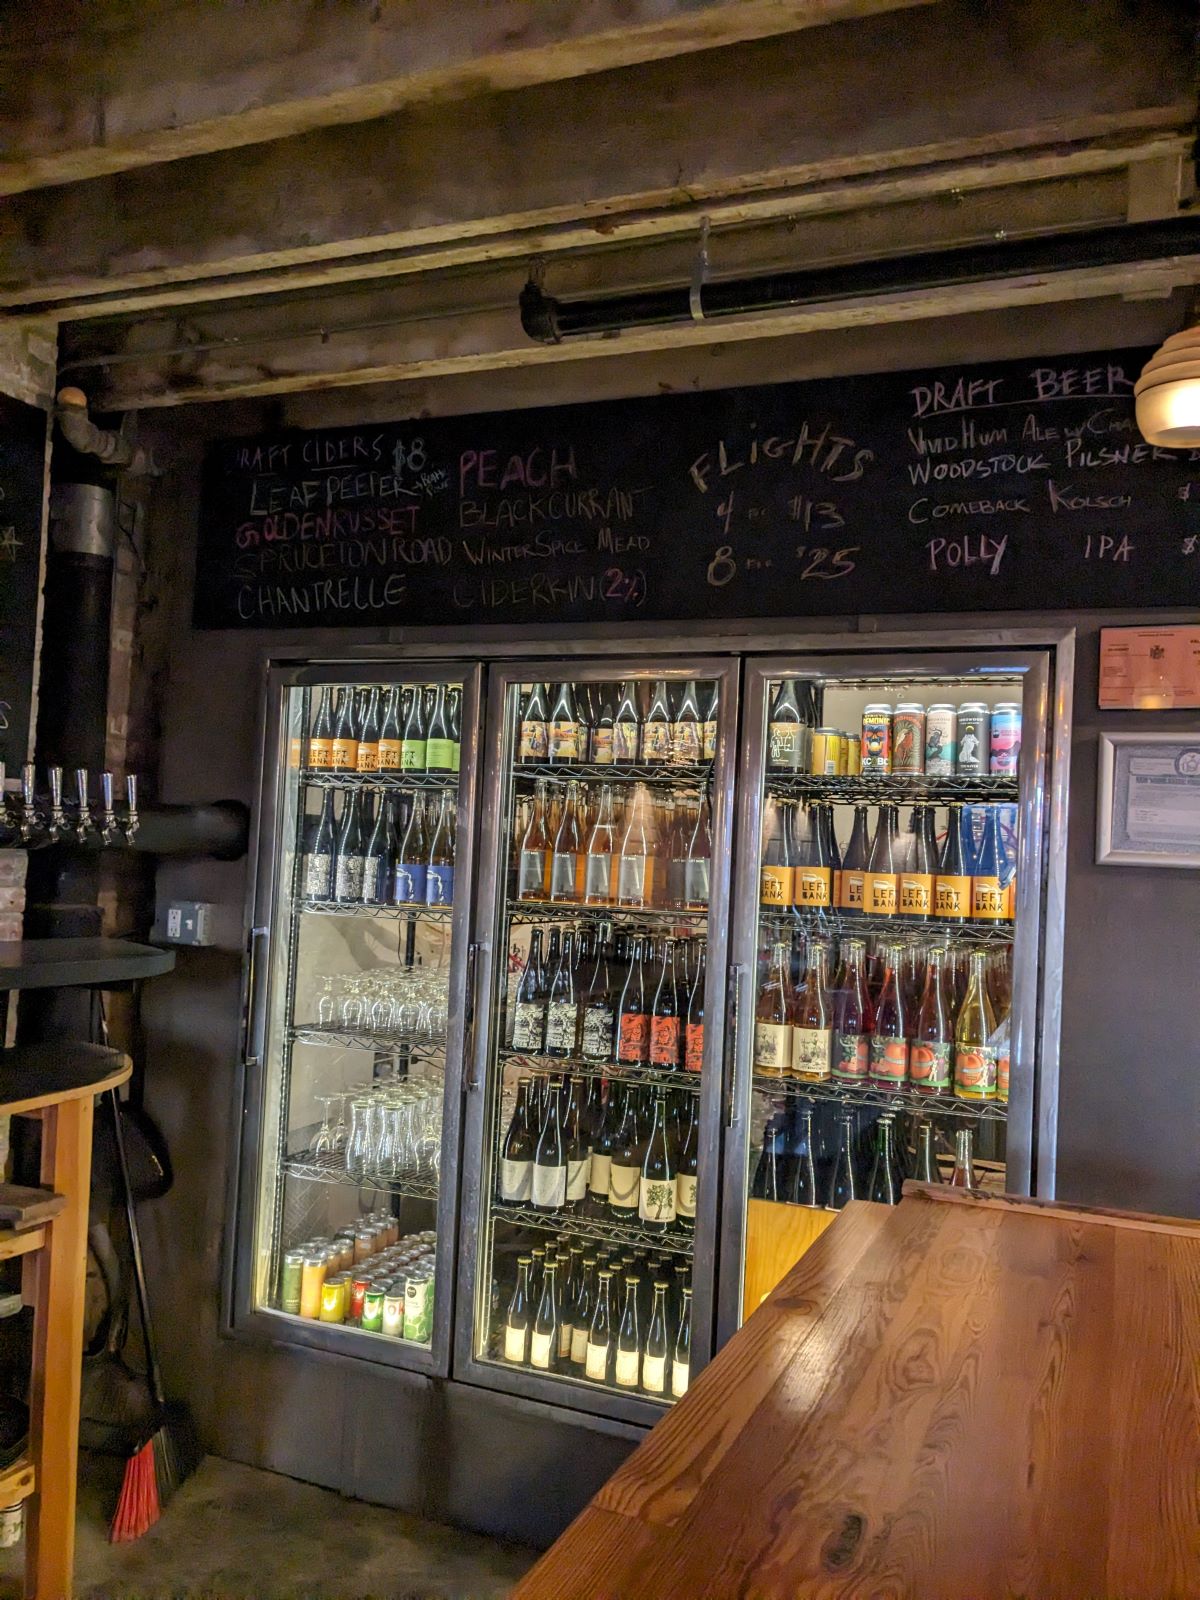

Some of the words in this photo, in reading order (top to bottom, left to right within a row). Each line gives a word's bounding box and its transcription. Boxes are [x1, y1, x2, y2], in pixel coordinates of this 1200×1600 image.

[911, 376, 1004, 418] DRAFT
[1030, 362, 1136, 401] BEER
[238, 443, 293, 472] RAFT
[303, 433, 385, 466] CIDERS
[909, 453, 1053, 487] WOODSTOCK
[1066, 437, 1179, 469] PILSNER
[459, 447, 578, 498] PEACH
[716, 490, 733, 535] 4
[908, 497, 1032, 524] COMEBACK
[1046, 479, 1132, 513] KOLSCH
[597, 526, 651, 555] MEAD
[925, 534, 1008, 575] POLLY
[1084, 534, 1135, 562] IPA
[707, 545, 737, 586] 8
[802, 881, 828, 892] LEFT
[802, 891, 827, 900] BANK
[849, 884, 863, 895] LE
[849, 894, 863, 903] BA
[902, 889, 929, 899] LEFT
[976, 892, 1003, 903] LEFT
[902, 899, 929, 909] BANK
[976, 902, 1003, 912] BANK
